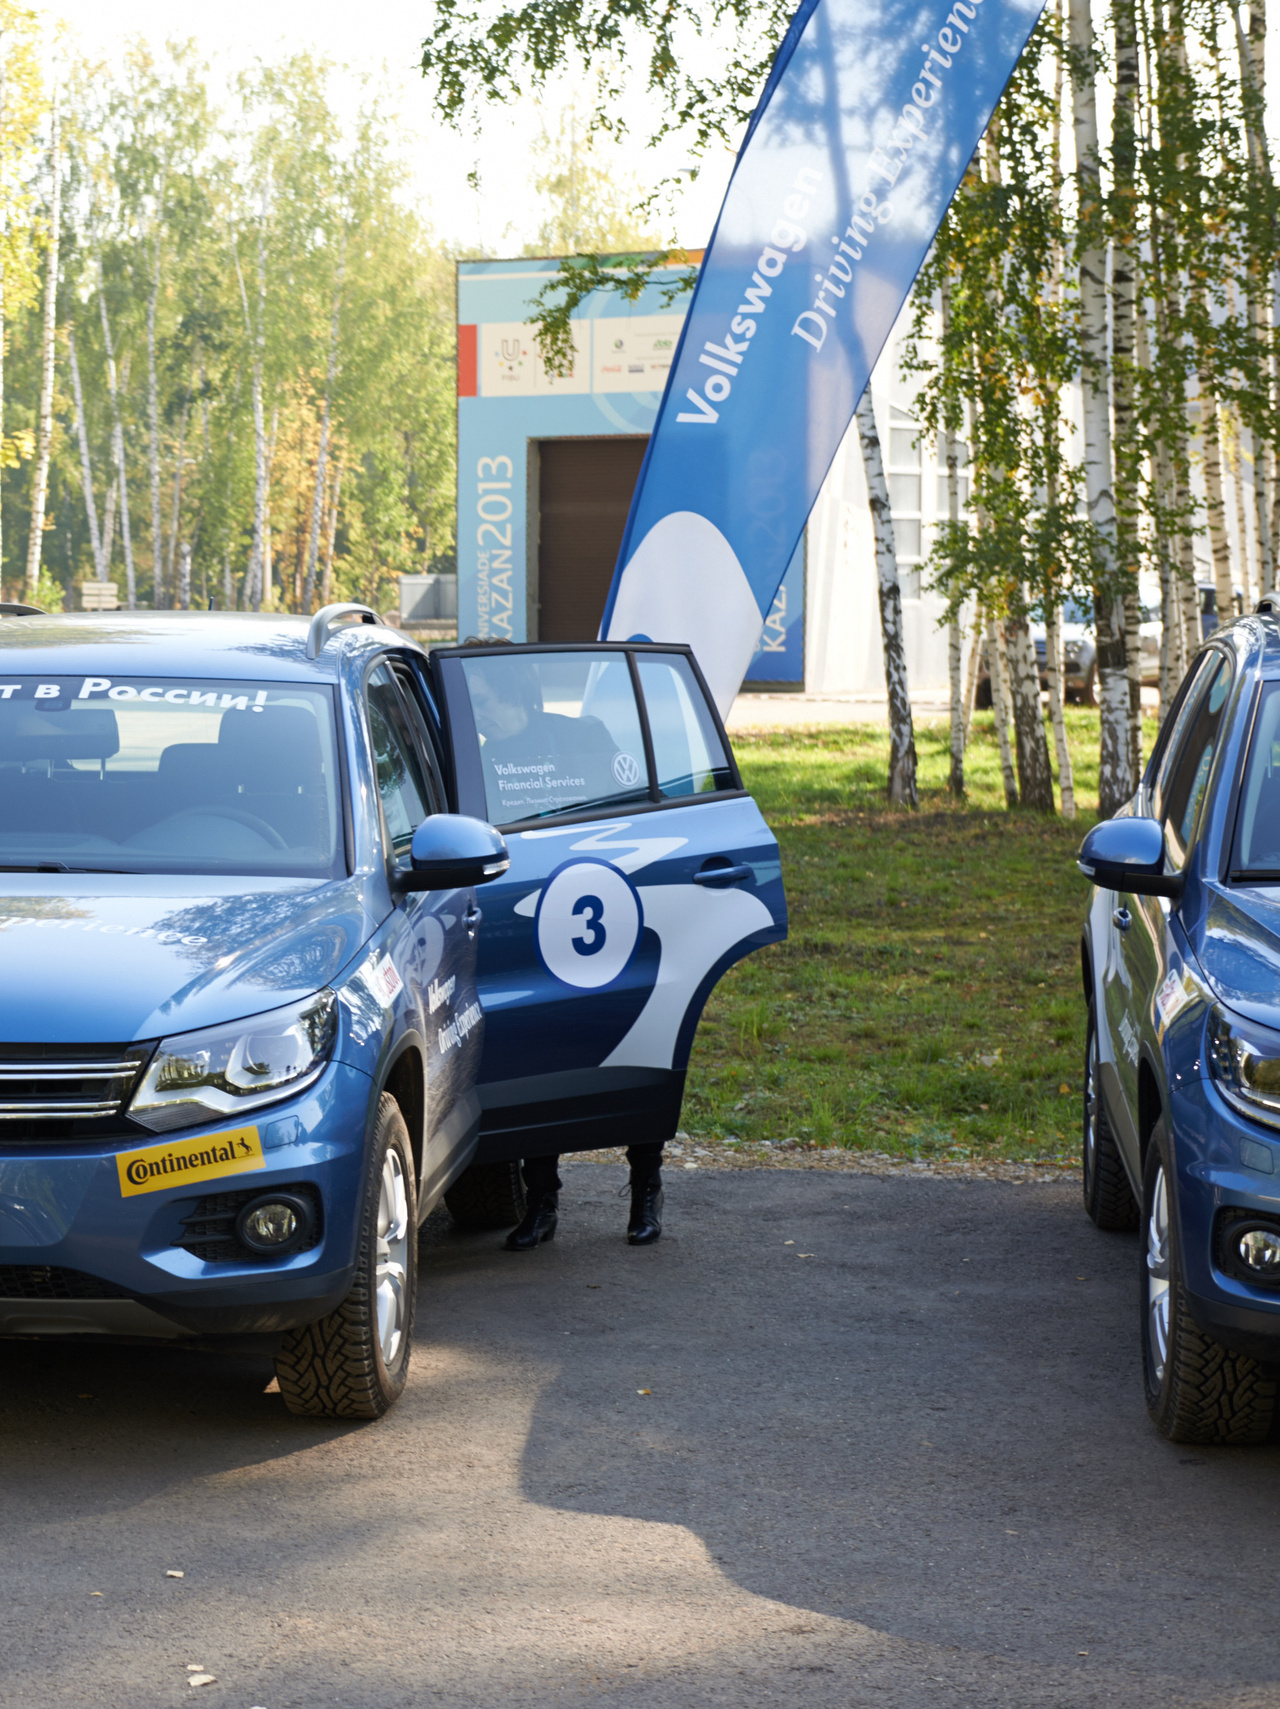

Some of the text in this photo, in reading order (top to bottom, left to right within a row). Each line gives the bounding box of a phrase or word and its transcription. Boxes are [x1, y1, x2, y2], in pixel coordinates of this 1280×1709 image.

[791, 0, 980, 353] Driving Experien
[675, 165, 823, 424] Volkswagen
[477, 550, 490, 641] NIVERSIADE
[34, 684, 61, 699] в
[78, 678, 268, 713] России!
[494, 762, 555, 776] Volkswagen
[498, 776, 586, 791] Financial Services
[571, 895, 607, 957] 3
[126, 1140, 238, 1186] Continental
